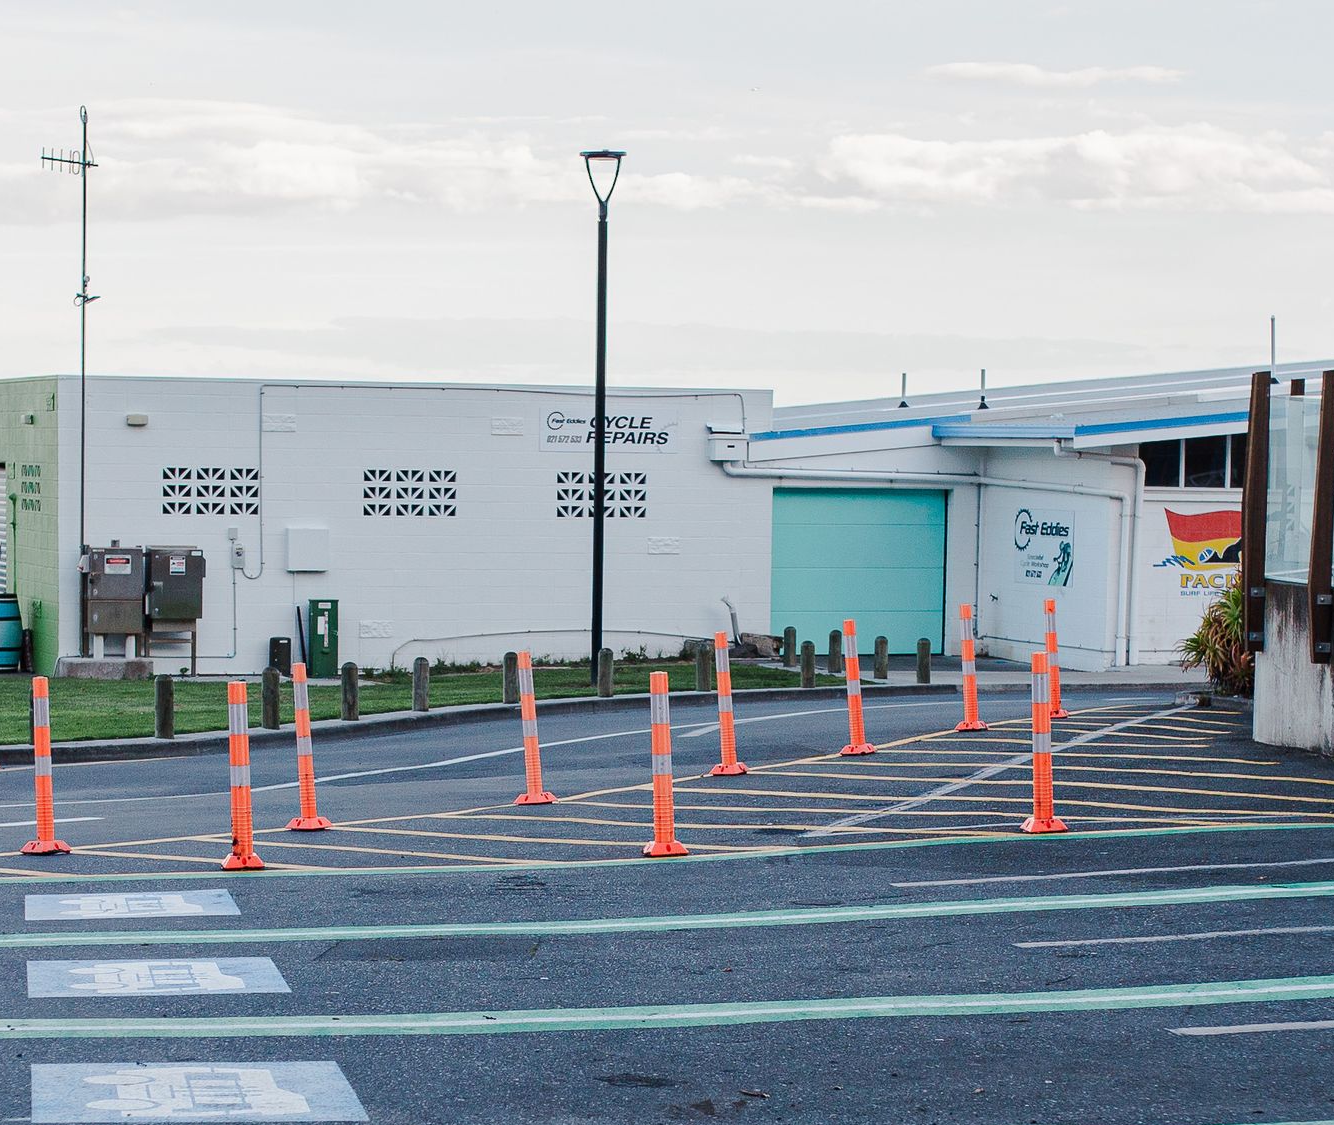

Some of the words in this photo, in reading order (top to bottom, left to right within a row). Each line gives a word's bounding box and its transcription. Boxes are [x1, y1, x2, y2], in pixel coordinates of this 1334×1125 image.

[1020, 521, 1039, 535] Fast
[1041, 522, 1069, 536] Eddies
[1180, 574, 1235, 588] PACI
